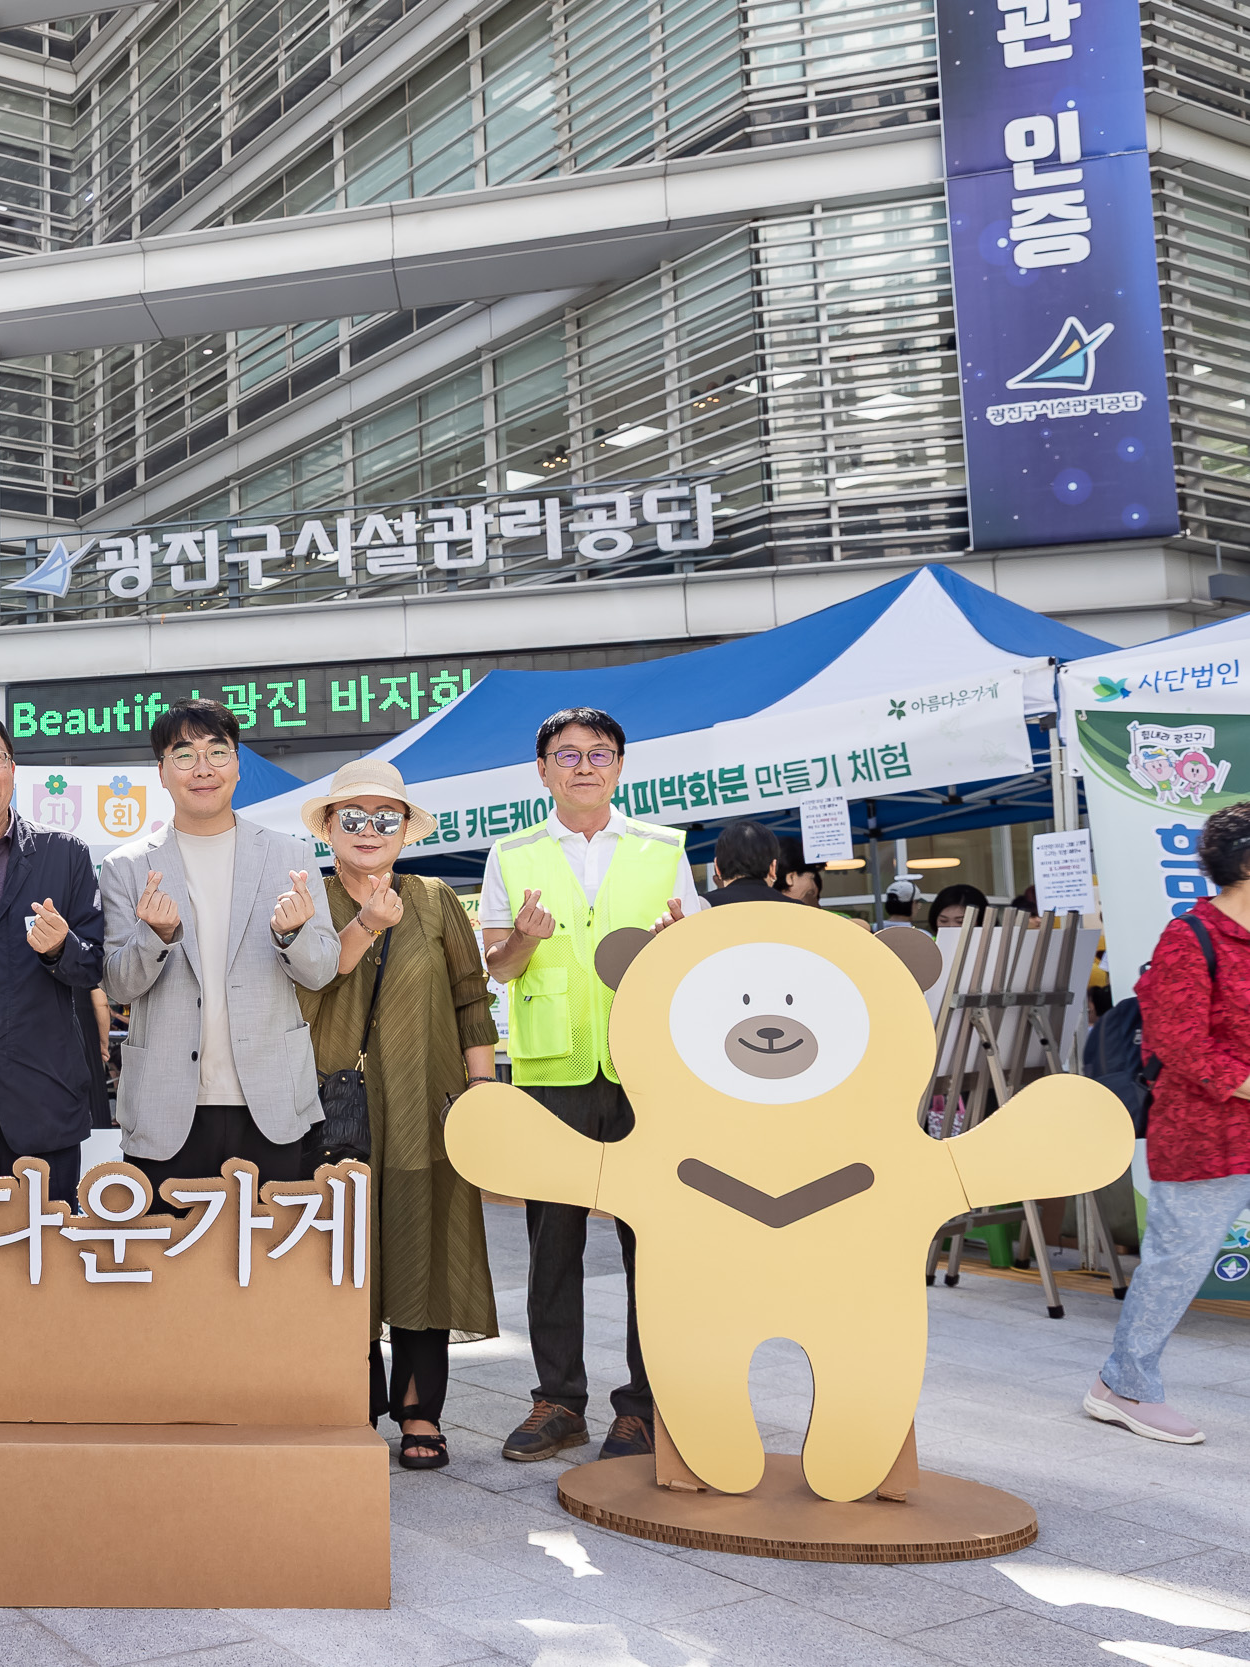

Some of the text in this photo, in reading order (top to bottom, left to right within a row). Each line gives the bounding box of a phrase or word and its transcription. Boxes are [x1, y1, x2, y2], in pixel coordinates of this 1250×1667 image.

[1003, 109, 1093, 270] 인증
[989, 392, 1142, 424] 광진구시설관리공단
[96, 483, 722, 599] 광진구시설관리공단
[1138, 658, 1240, 694] 사단법인
[13, 668, 471, 738] Beautif 광진 바자회
[910, 681, 1000, 715] 아름다운가게
[1140, 729, 1171, 741] 힘내라
[465, 795, 554, 839] 카드케이
[754, 754, 842, 798] 만들기
[847, 741, 912, 783] 체험
[47, 801, 69, 826] 자
[112, 802, 133, 826] 회
